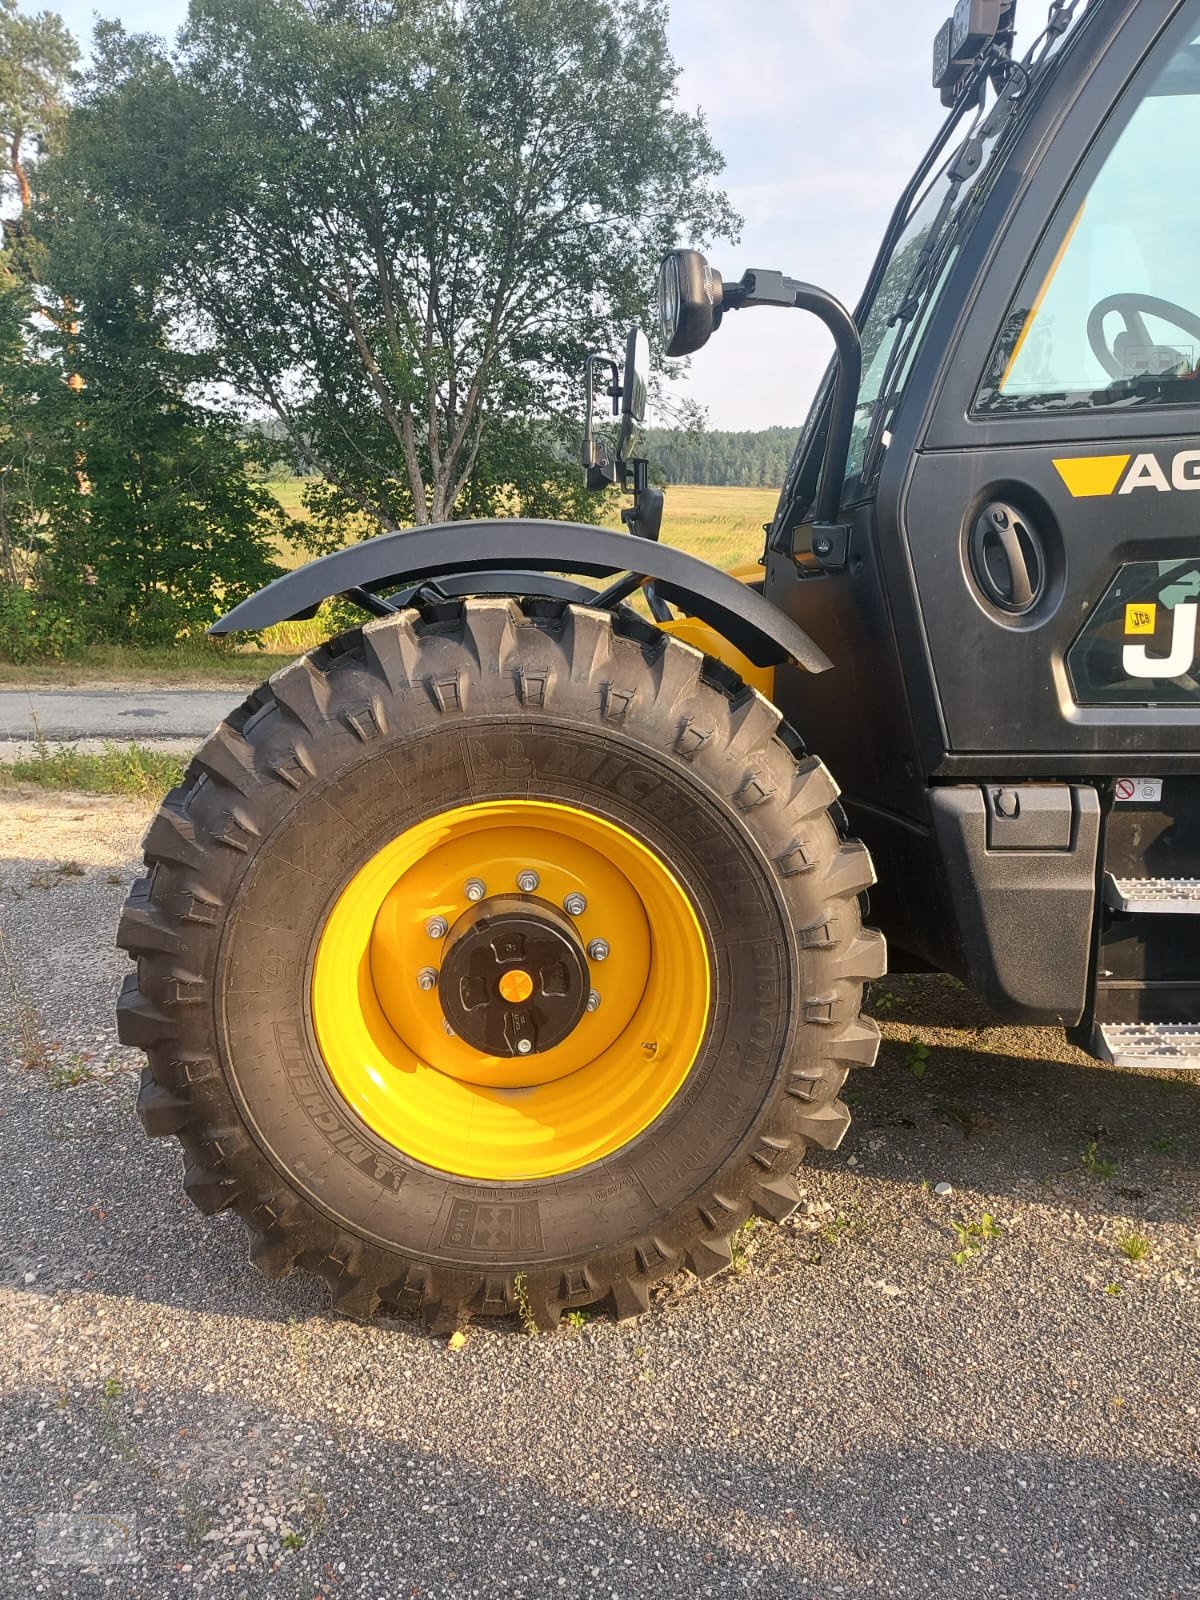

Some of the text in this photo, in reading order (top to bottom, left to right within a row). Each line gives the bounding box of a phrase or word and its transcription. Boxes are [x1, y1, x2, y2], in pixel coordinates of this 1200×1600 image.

[1122, 603, 1198, 679] J
[1134, 611, 1151, 626] JCB
[277, 1022, 372, 1164] MICHELIN
[451, 1208, 470, 1242] Line
